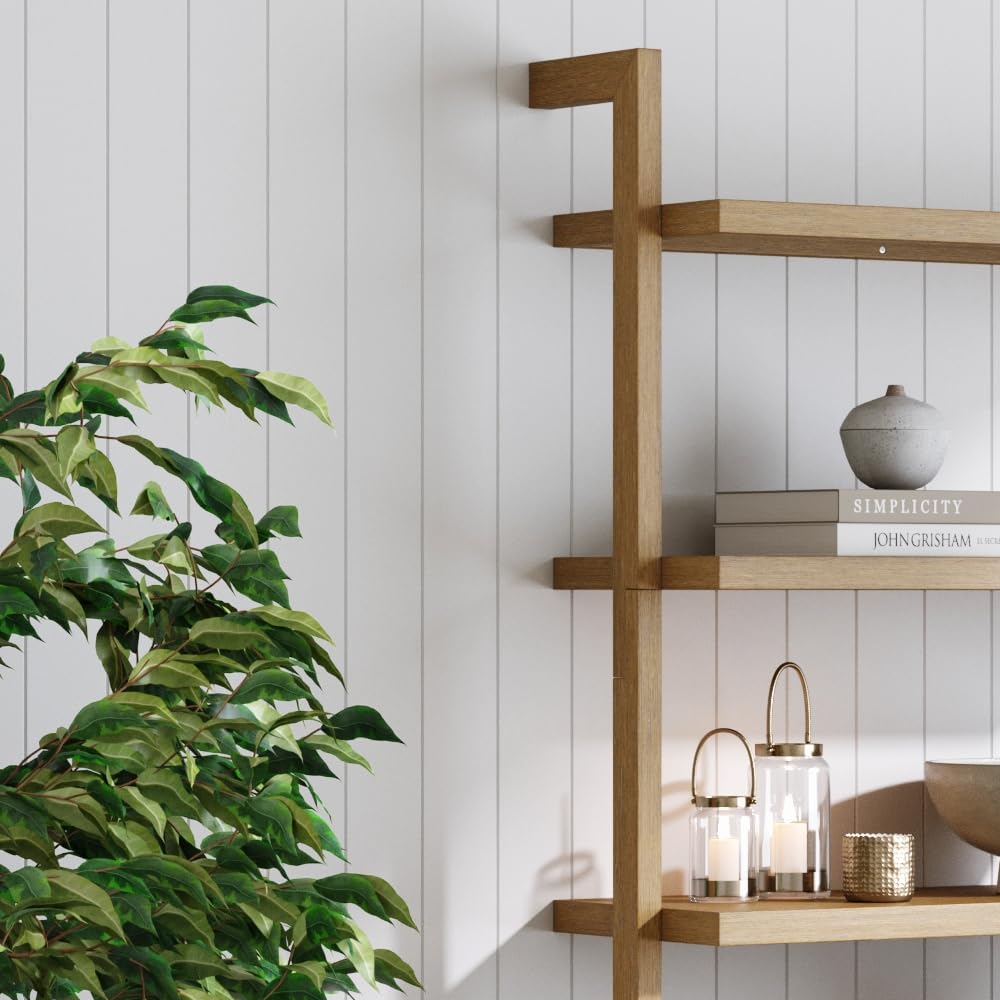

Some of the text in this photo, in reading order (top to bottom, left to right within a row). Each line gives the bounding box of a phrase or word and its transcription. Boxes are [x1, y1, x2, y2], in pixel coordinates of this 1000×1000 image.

[853, 498, 962, 514] SIMPLICITY
[873, 532, 909, 550] JOHN
[910, 532, 970, 547] GRISHAM
